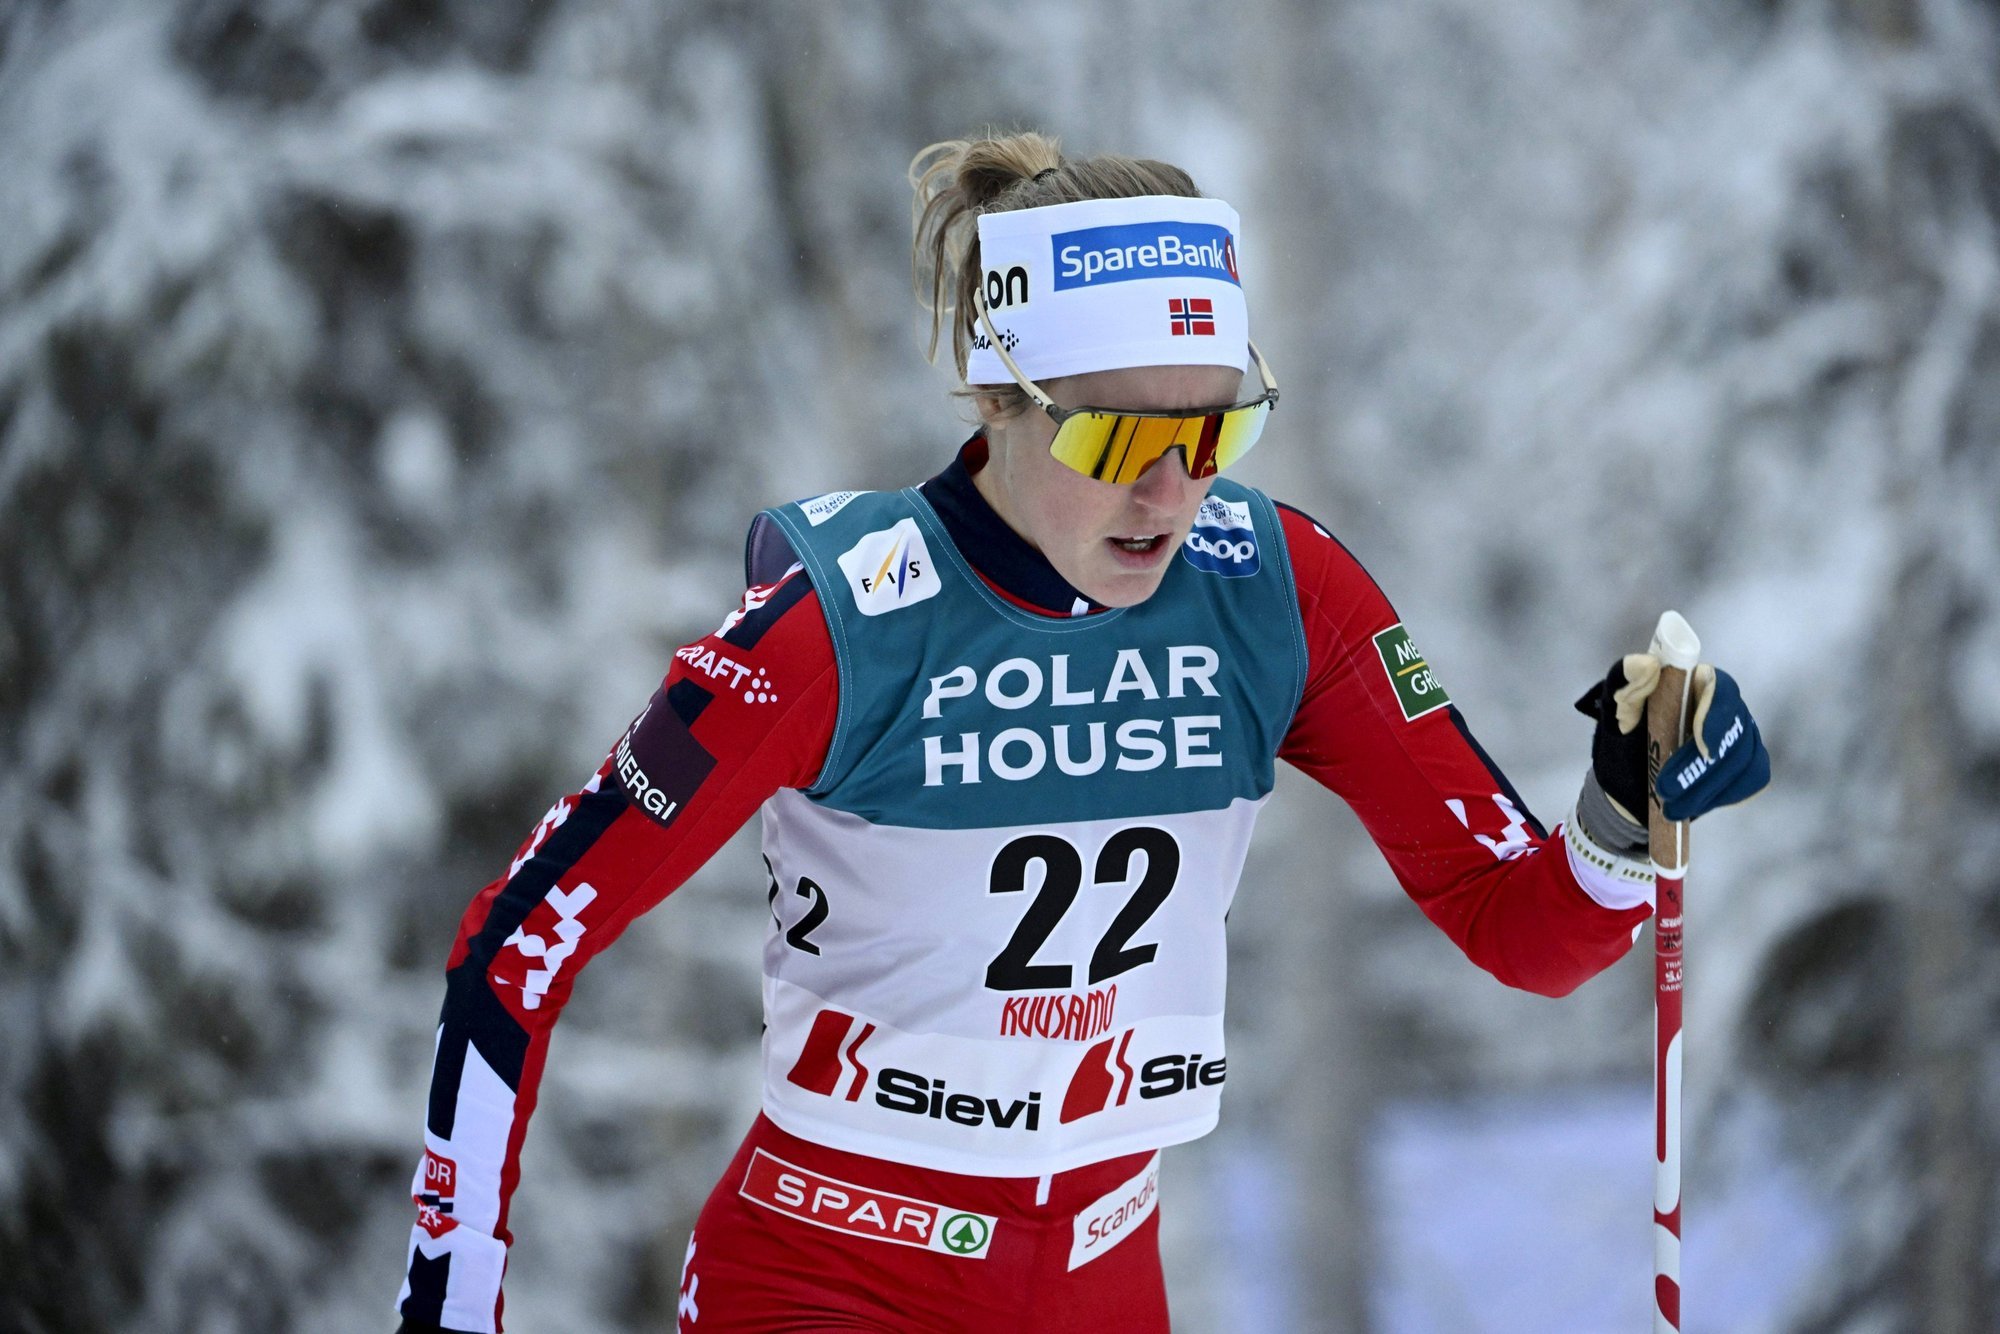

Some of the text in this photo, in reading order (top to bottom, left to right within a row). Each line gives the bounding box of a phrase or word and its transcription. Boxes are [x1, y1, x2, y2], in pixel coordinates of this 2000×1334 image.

[983, 266, 1028, 310] on
[1060, 235, 1225, 282] SpareBank
[675, 645, 752, 690] CRAFT
[921, 645, 1221, 720] POLAR
[922, 715, 1223, 787] HOUSE
[1677, 715, 1744, 790] lillport
[985, 826, 1181, 991] 22
[1000, 983, 1117, 1041] KUUSAMO
[876, 1067, 1041, 1131] Sievi
[426, 1154, 451, 1186] OR
[774, 1173, 932, 1238] SPAR
